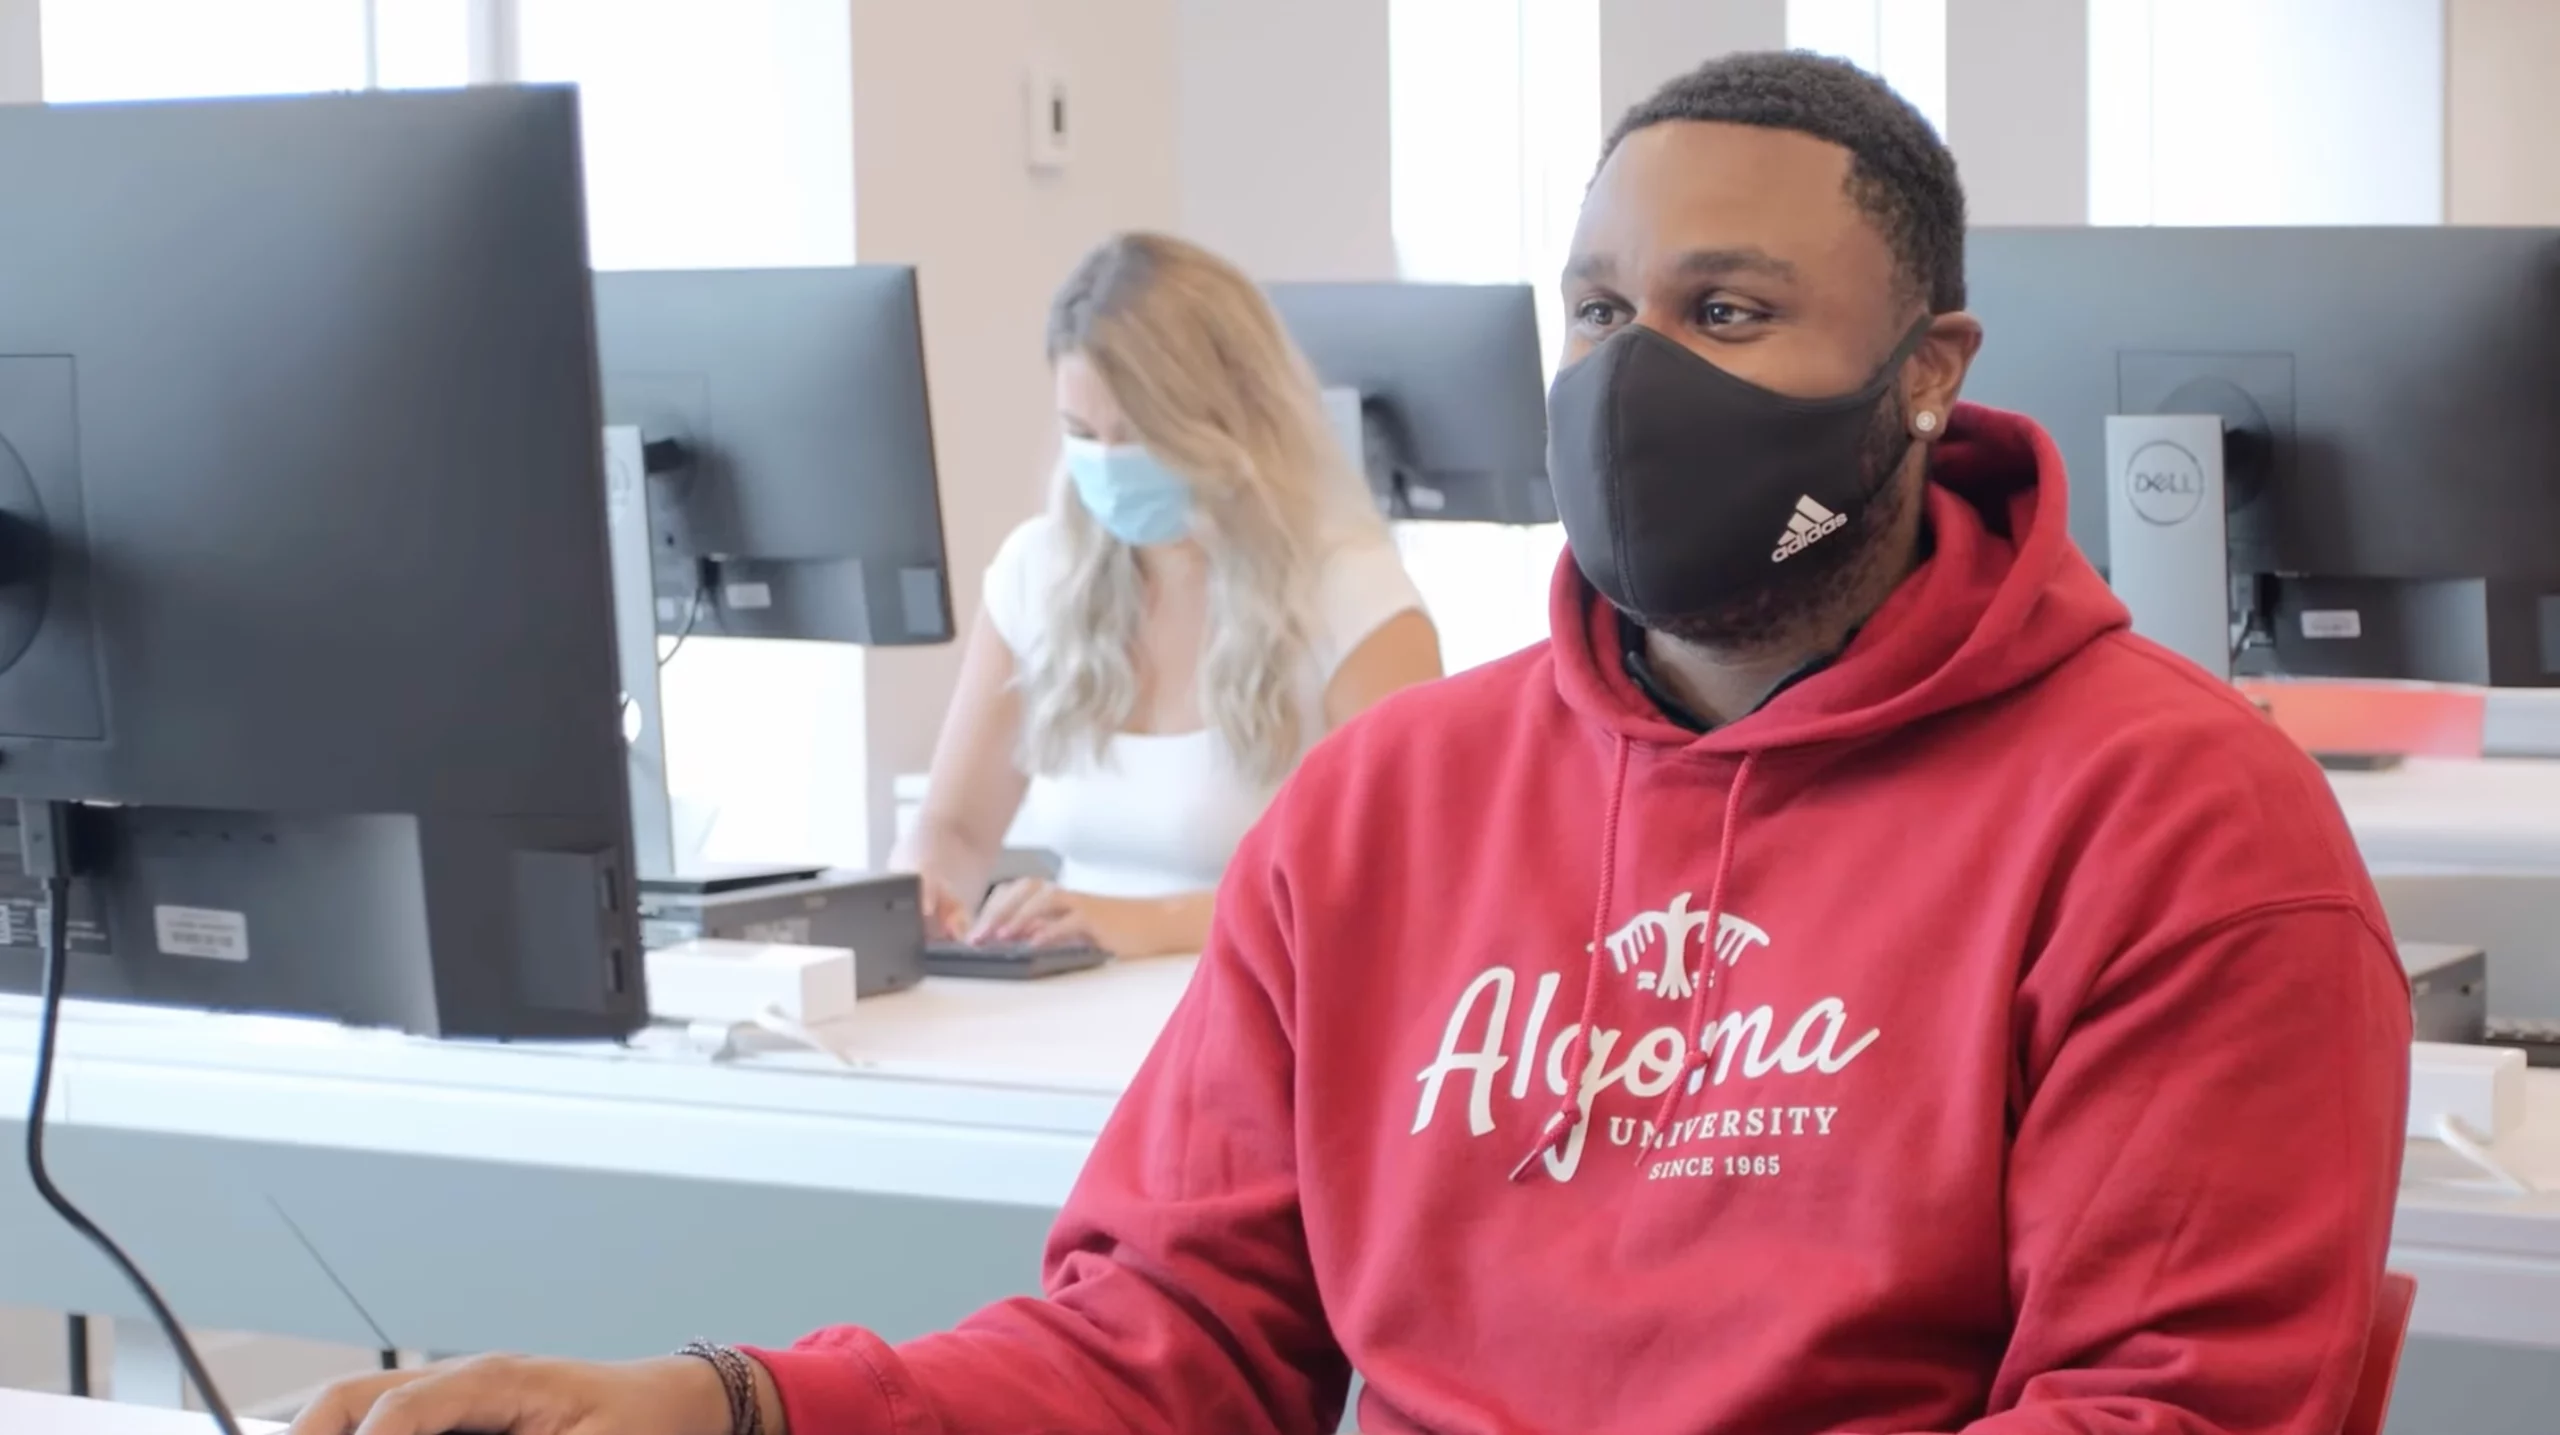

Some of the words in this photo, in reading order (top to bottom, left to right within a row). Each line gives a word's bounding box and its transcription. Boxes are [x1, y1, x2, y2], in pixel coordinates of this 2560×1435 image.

[2134, 471, 2195, 494] DELL
[1771, 512, 1848, 563] adidas
[1411, 966, 1881, 1183] Algoma
[1609, 1106, 1838, 1150] UNIVERSITY
[1648, 1156, 1714, 1180] SINCE
[1724, 1155, 1781, 1176] 1965
